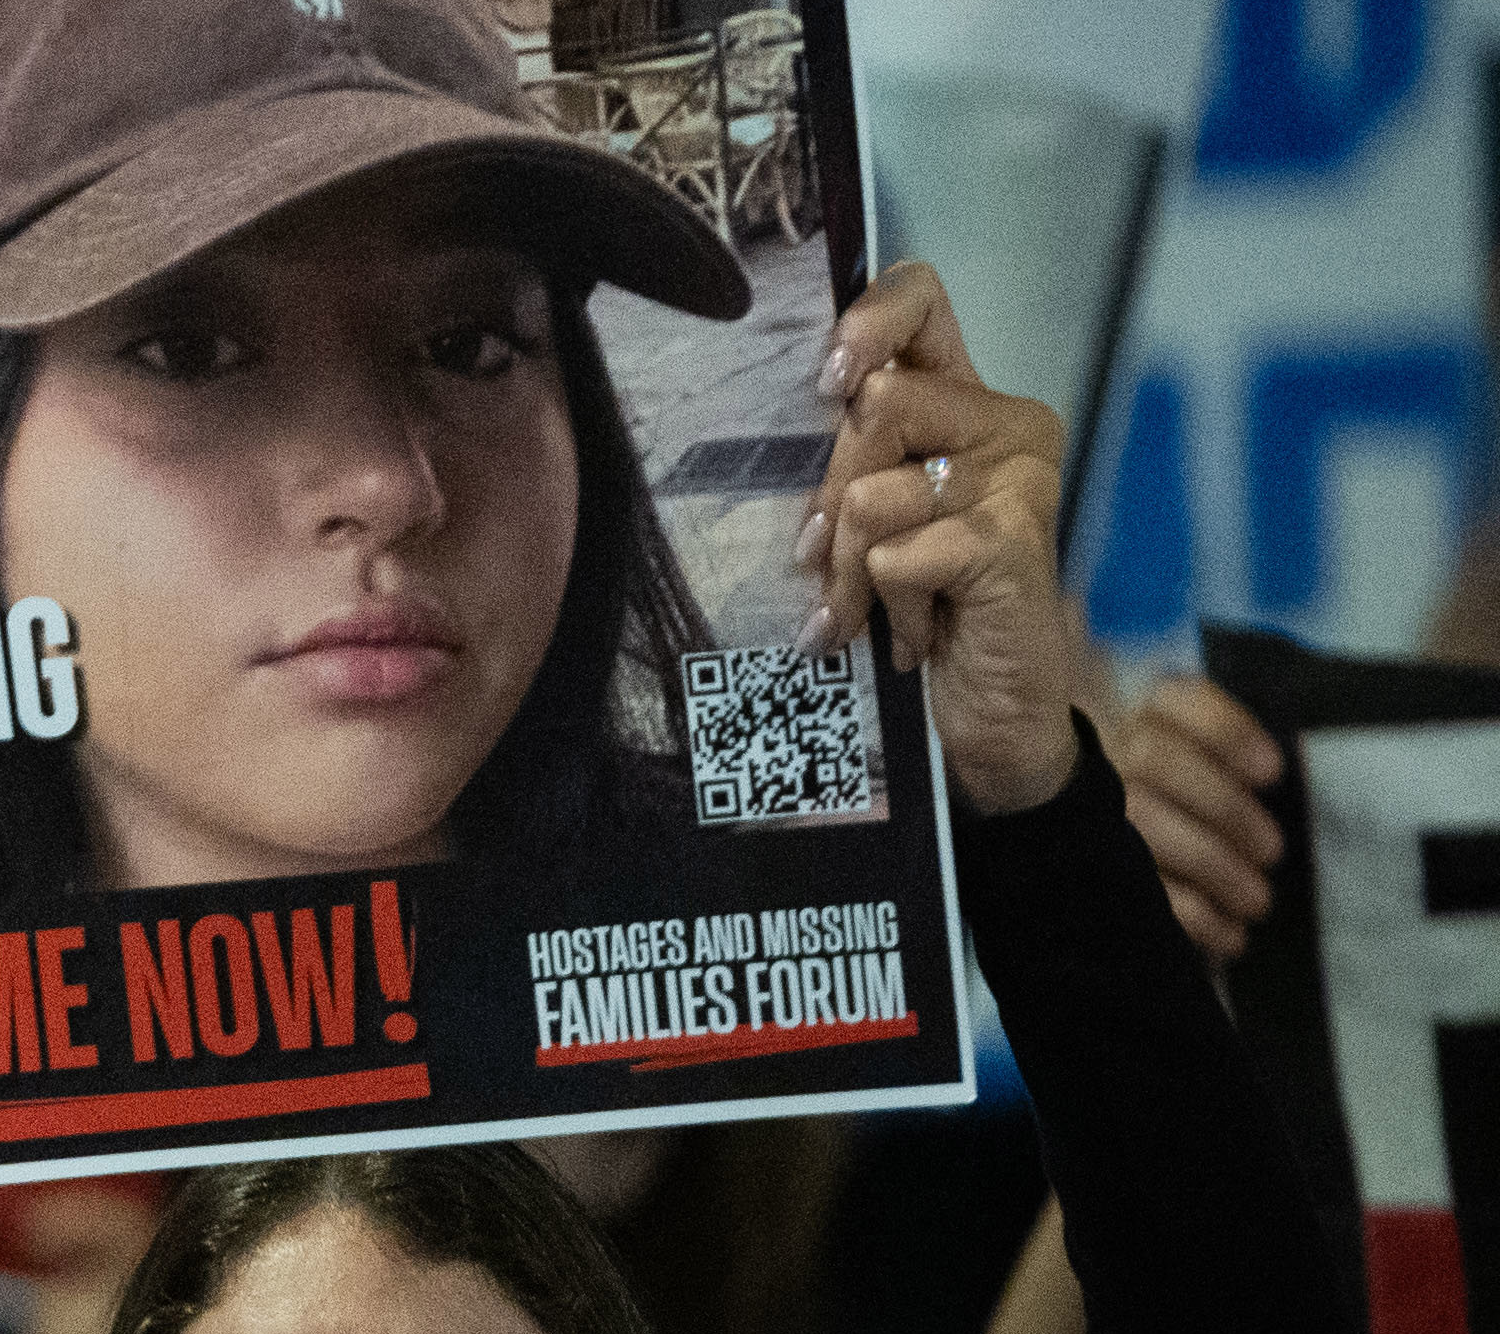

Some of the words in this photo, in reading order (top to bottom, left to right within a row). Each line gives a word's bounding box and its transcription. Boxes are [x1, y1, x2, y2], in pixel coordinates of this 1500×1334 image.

[118, 880, 419, 1064] NOW!
[527, 919, 688, 980] HOSTAGES
[693, 912, 757, 965] AND
[758, 899, 901, 958] MISSING
[533, 965, 739, 1050] FAMILIES
[745, 950, 909, 1032] FORUM
